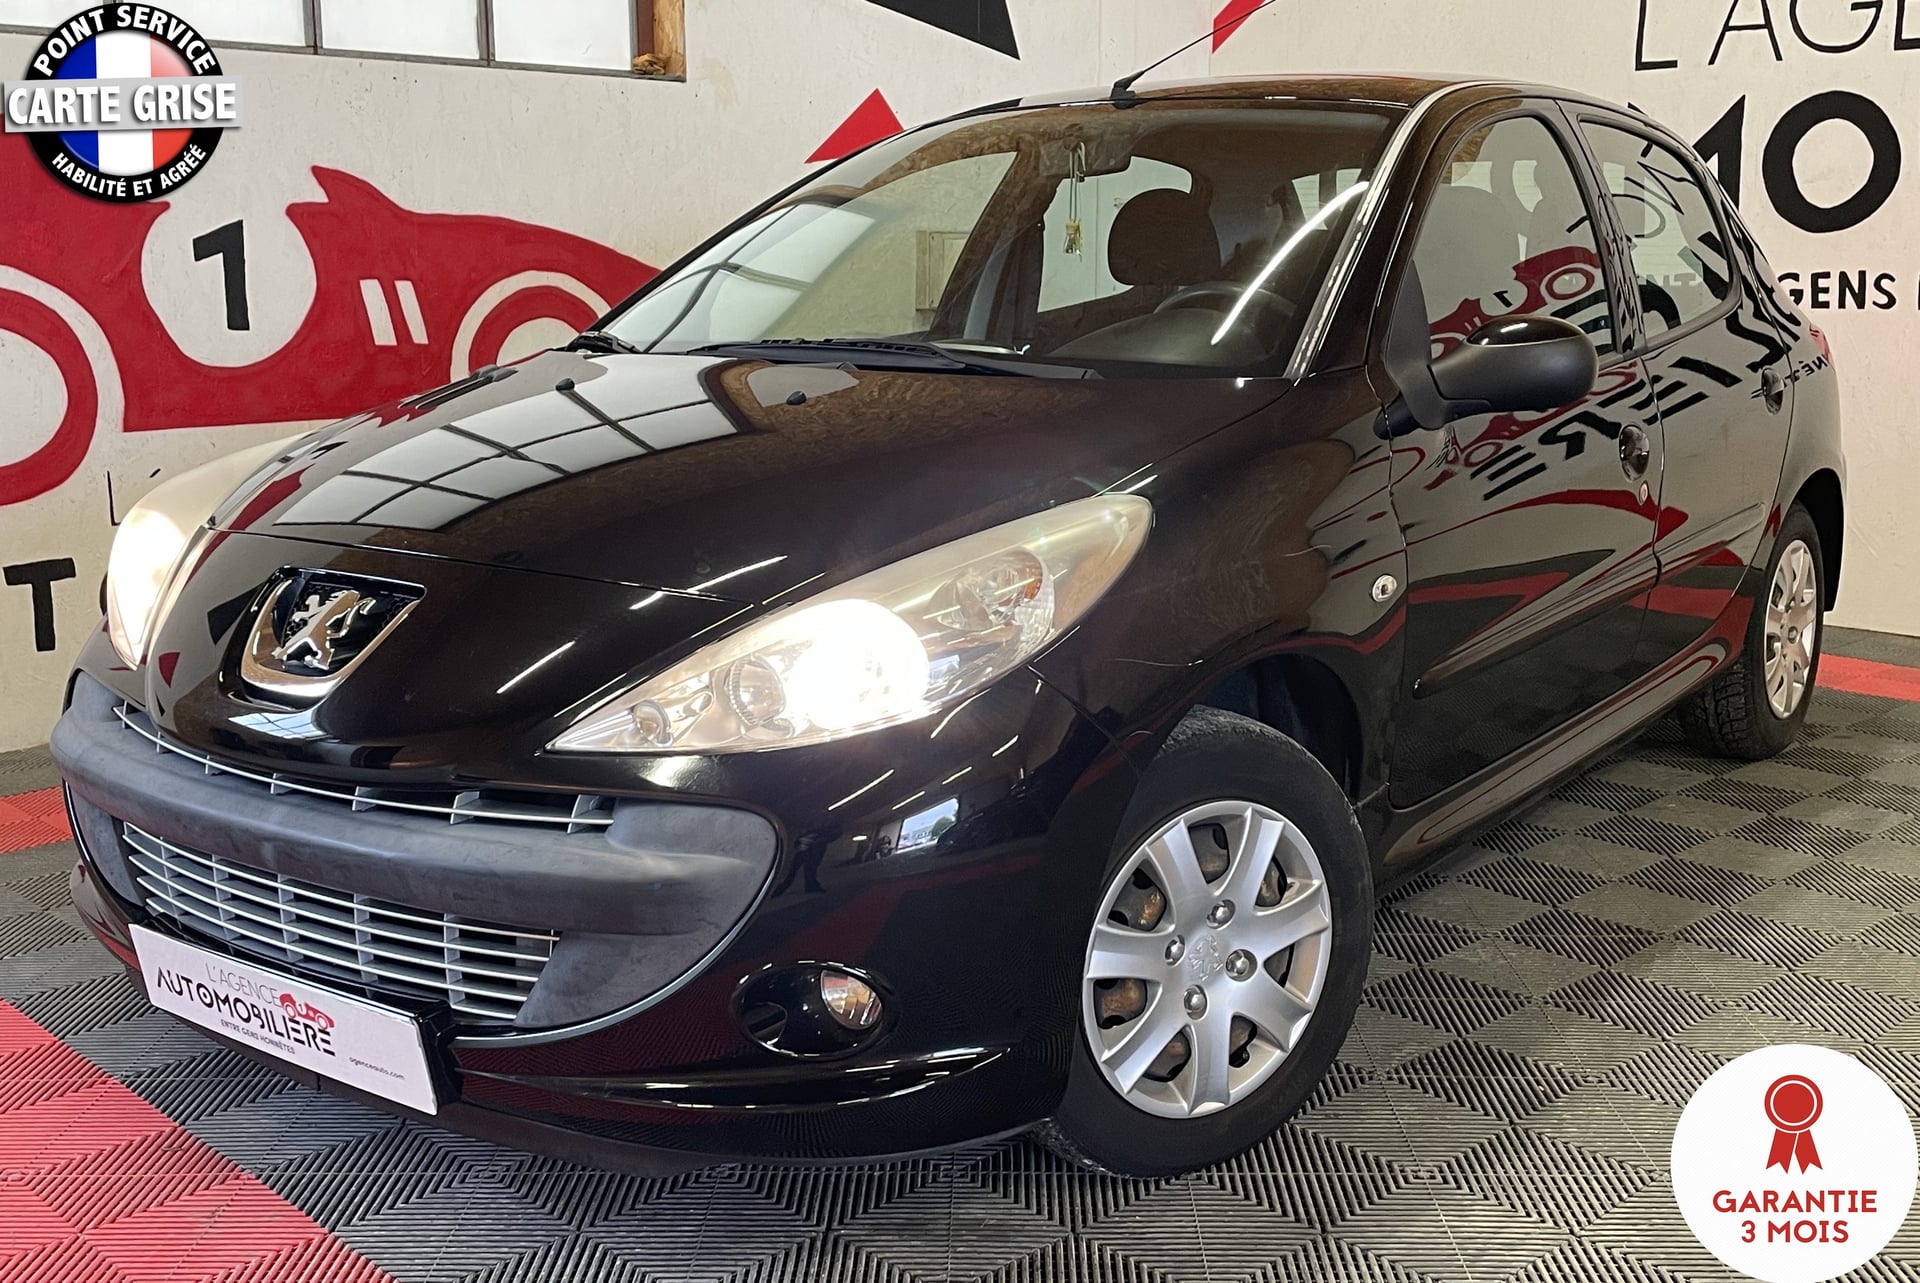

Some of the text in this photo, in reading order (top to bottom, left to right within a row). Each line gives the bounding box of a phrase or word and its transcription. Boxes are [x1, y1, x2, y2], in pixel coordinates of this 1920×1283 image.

[192, 219, 250, 331] 1
[205, 963, 281, 1008] L'AGENCE
[221, 1019, 241, 1033] ENTRE
[242, 1027, 260, 1040] GENS
